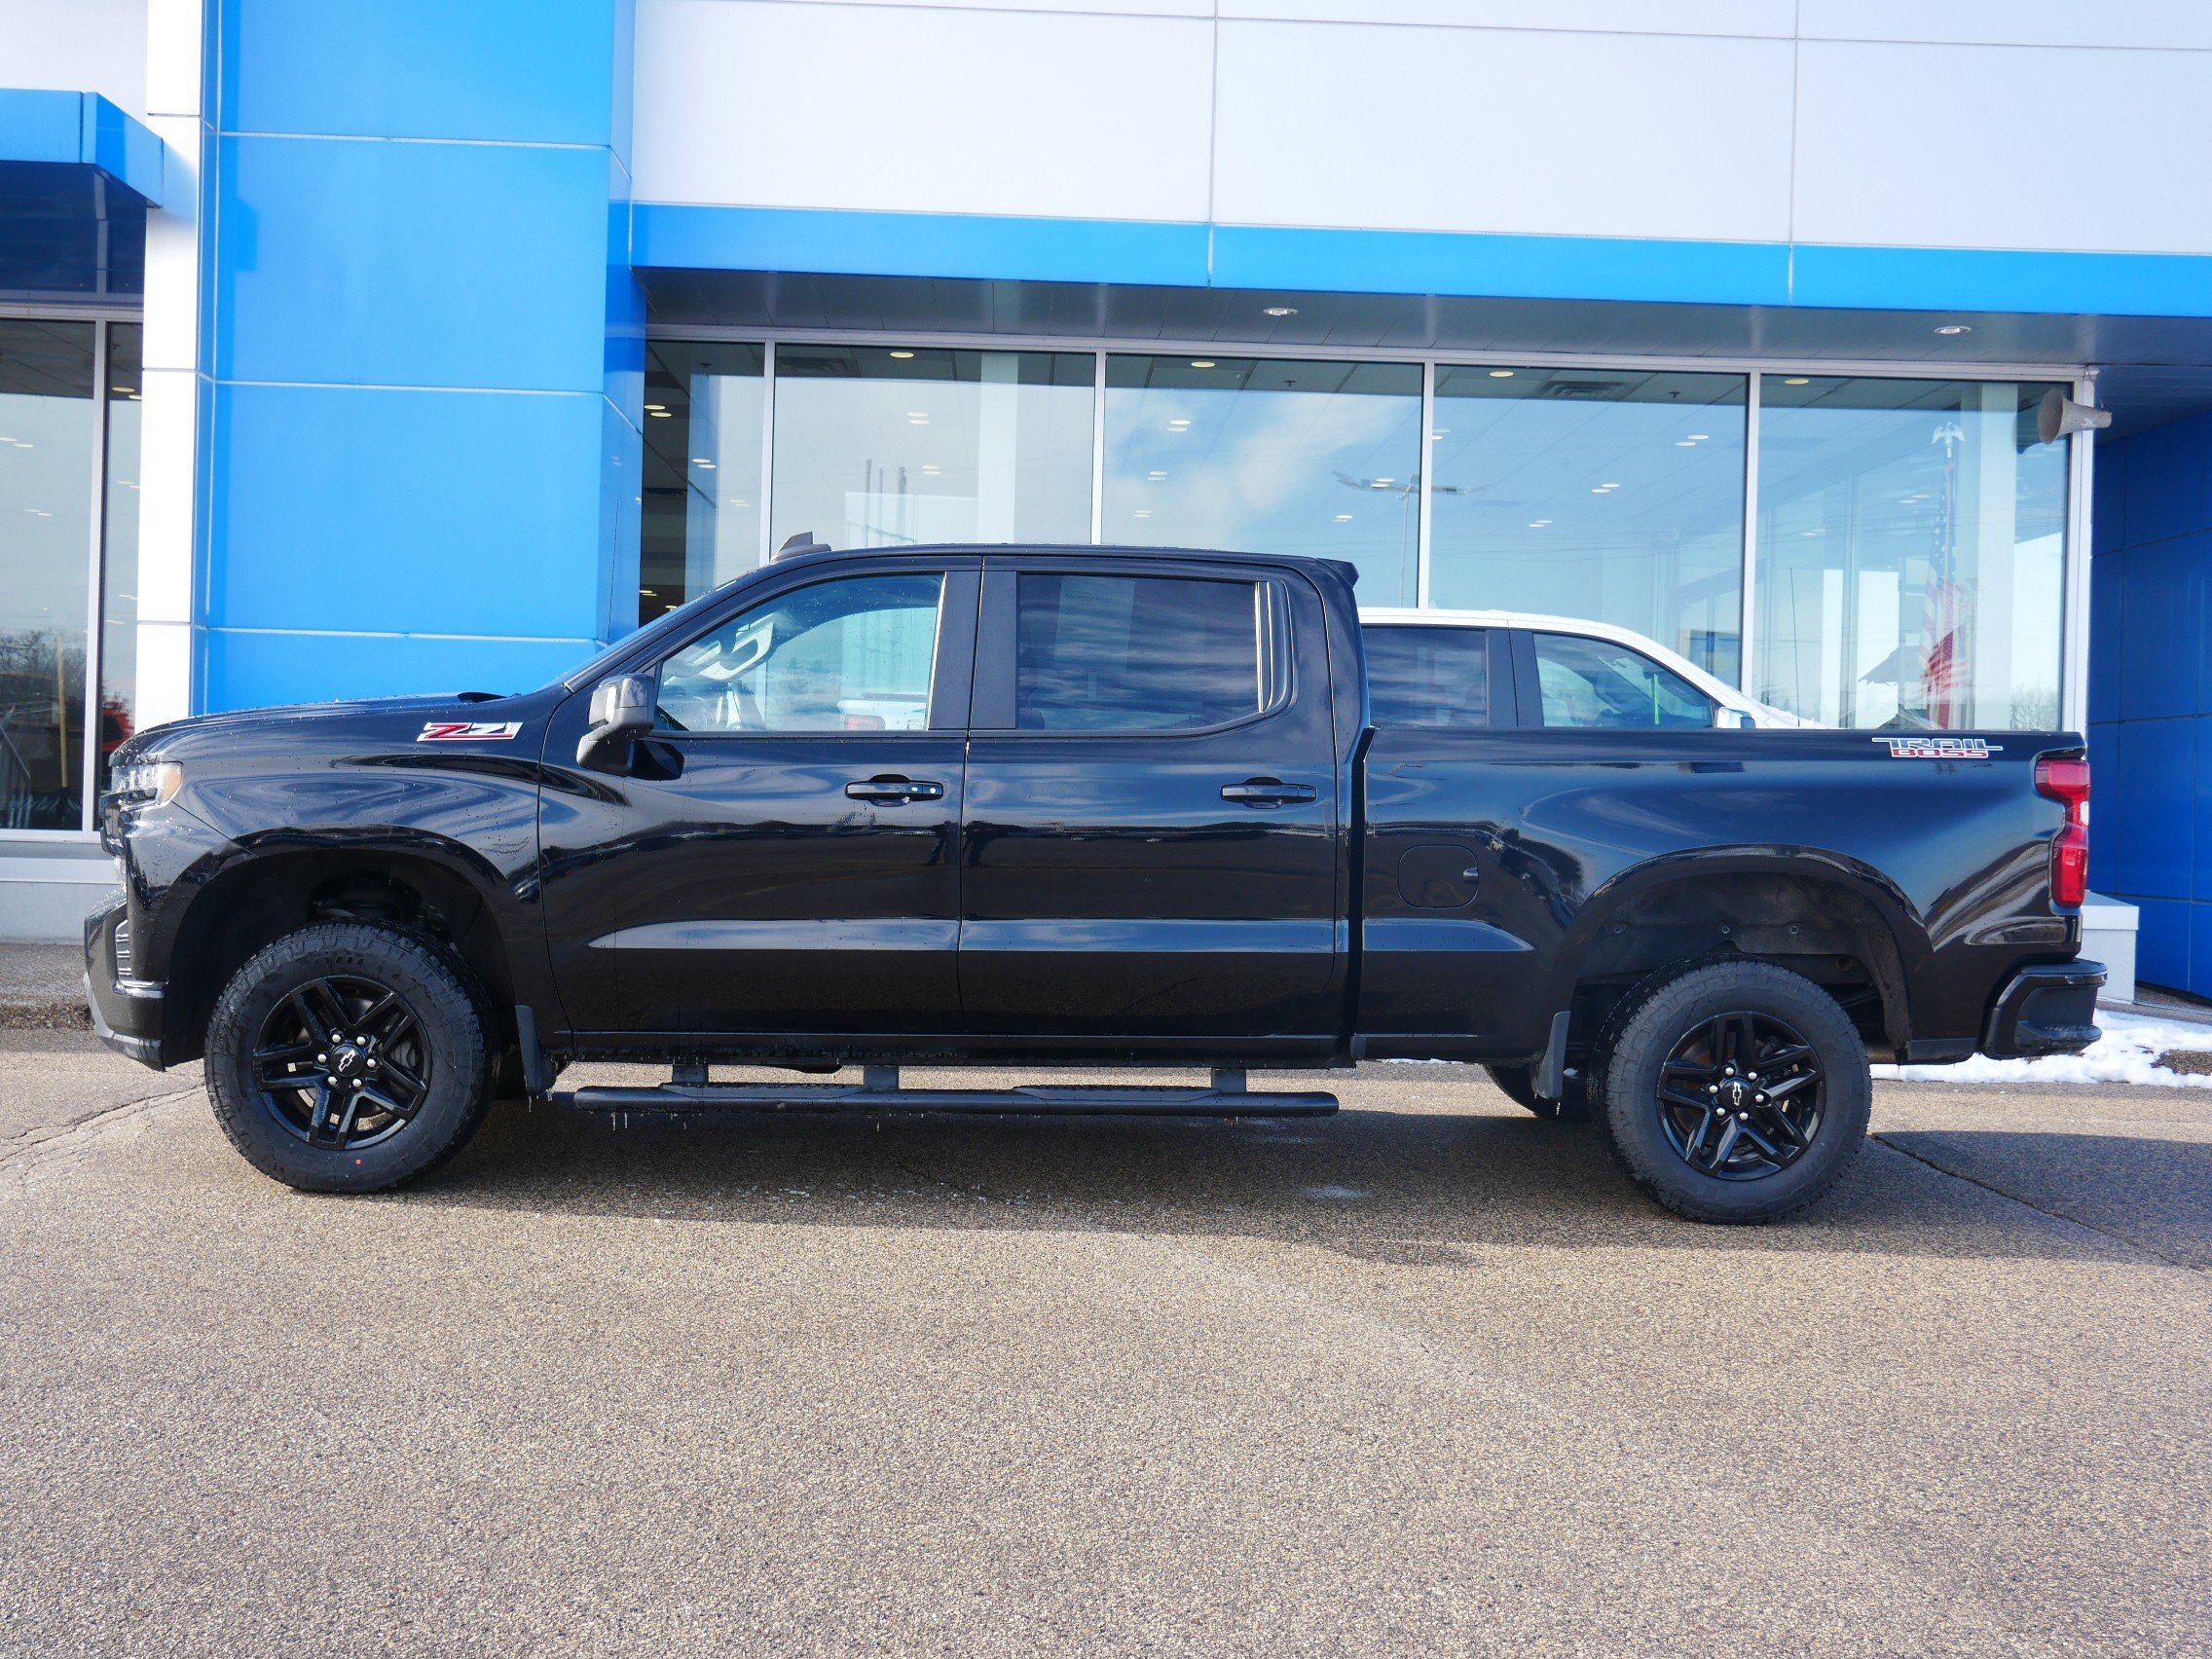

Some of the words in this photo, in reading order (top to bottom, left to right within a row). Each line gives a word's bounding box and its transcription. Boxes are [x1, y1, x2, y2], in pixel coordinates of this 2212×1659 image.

[417, 721, 524, 742] Z71
[1871, 737, 2004, 751] TRAIL
[1892, 748, 1989, 758] BOSS
